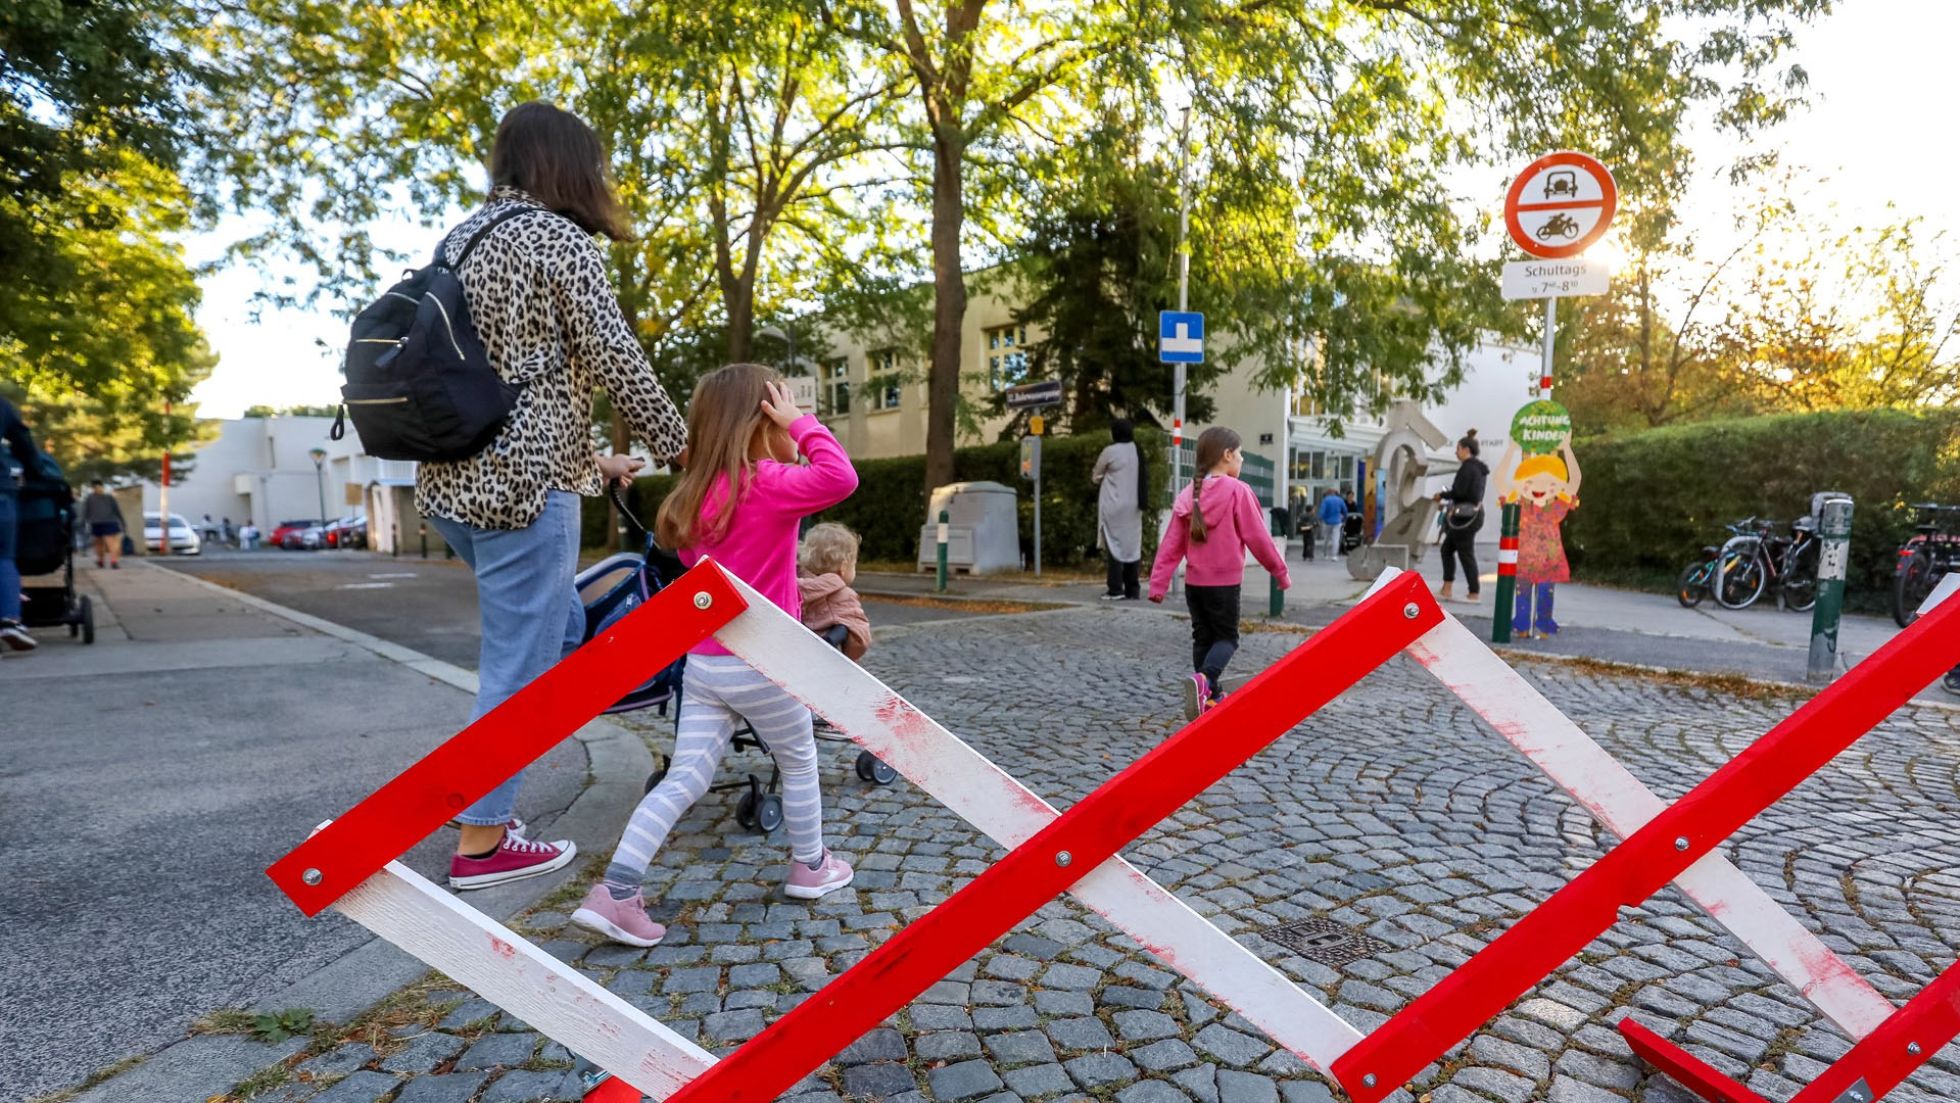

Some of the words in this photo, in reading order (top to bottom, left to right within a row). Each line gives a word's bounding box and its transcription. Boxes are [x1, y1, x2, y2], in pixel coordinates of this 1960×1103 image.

[1525, 265, 1586, 277] Schultags
[1519, 415, 1570, 426] ACHTUNG
[1523, 429, 1565, 441] KINDER
